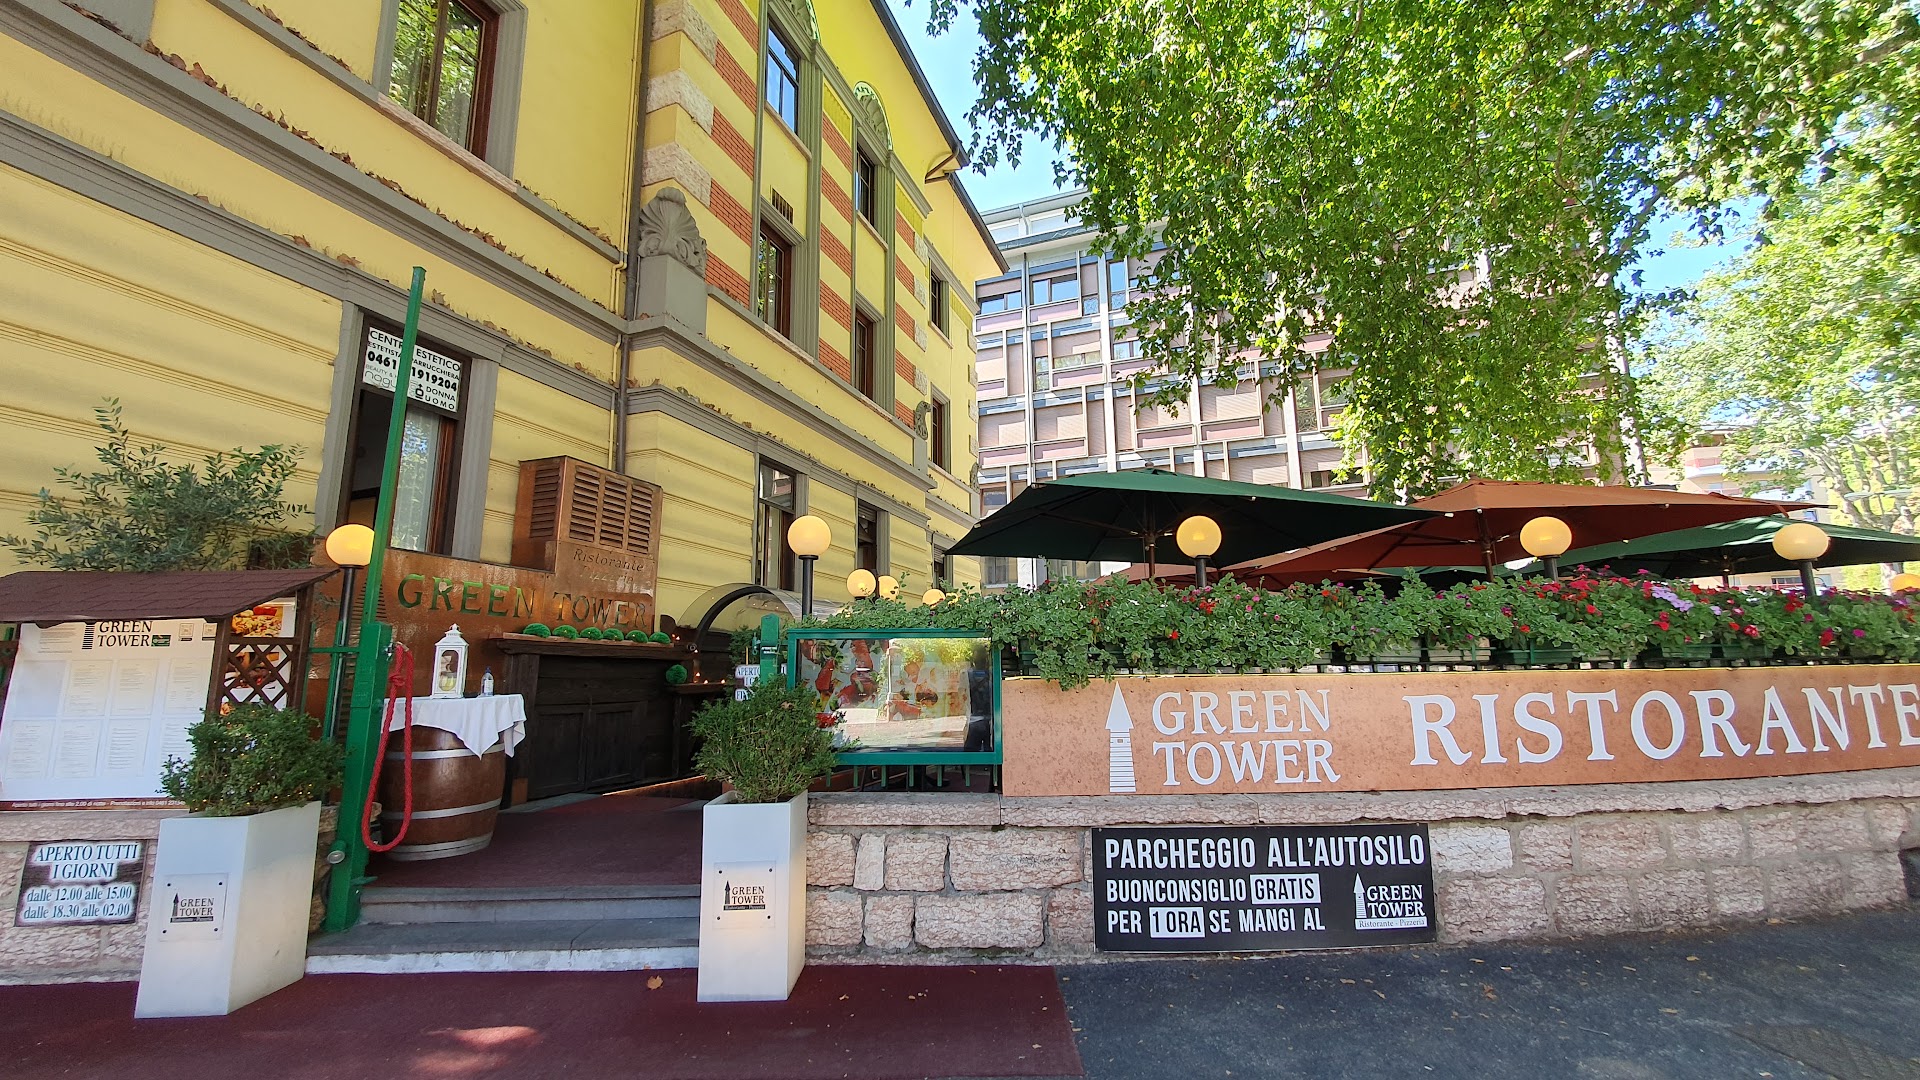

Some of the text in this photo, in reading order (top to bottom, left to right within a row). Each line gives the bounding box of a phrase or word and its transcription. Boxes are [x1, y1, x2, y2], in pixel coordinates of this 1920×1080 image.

[416, 348, 461, 372] ESTETICO
[367, 351, 458, 391] 0461 1919204
[412, 358, 460, 381] ARRUCCHIERA
[426, 386, 456, 402] DONNA
[425, 395, 455, 410] UOMO
[574, 548, 644, 572] Ristorante
[397, 573, 648, 628] GREEN TOWER
[99, 621, 153, 633] GREEN
[97, 635, 150, 647] TOWER
[1152, 689, 1331, 736] GREEN
[1402, 683, 1920, 766] RISTORANTE
[1153, 739, 1342, 787] TOWER
[36, 844, 139, 862] APERTO TUTTI
[1105, 835, 1425, 869] PARCHEGGIO ALL'AUTOSILO
[53, 863, 114, 879] I GIORNI
[27, 885, 132, 902] dalle 12.00 alle 15.00
[731, 886, 765, 895] GREEN
[1106, 878, 1315, 903] BUONCONSIGLIO GRATIS
[1366, 885, 1423, 901] GREEN
[180, 898, 215, 907] GREEN
[731, 895, 765, 904] TOWER
[24, 903, 130, 919] dalle 18.30 alle 02.00
[179, 907, 213, 917] TOWER
[1367, 902, 1426, 918] TOWER
[1107, 907, 1326, 934] PER 1 ORA SE MANGI AL
[1359, 920, 1394, 928] Ristorante
[1399, 918, 1425, 927] Pizzeria
